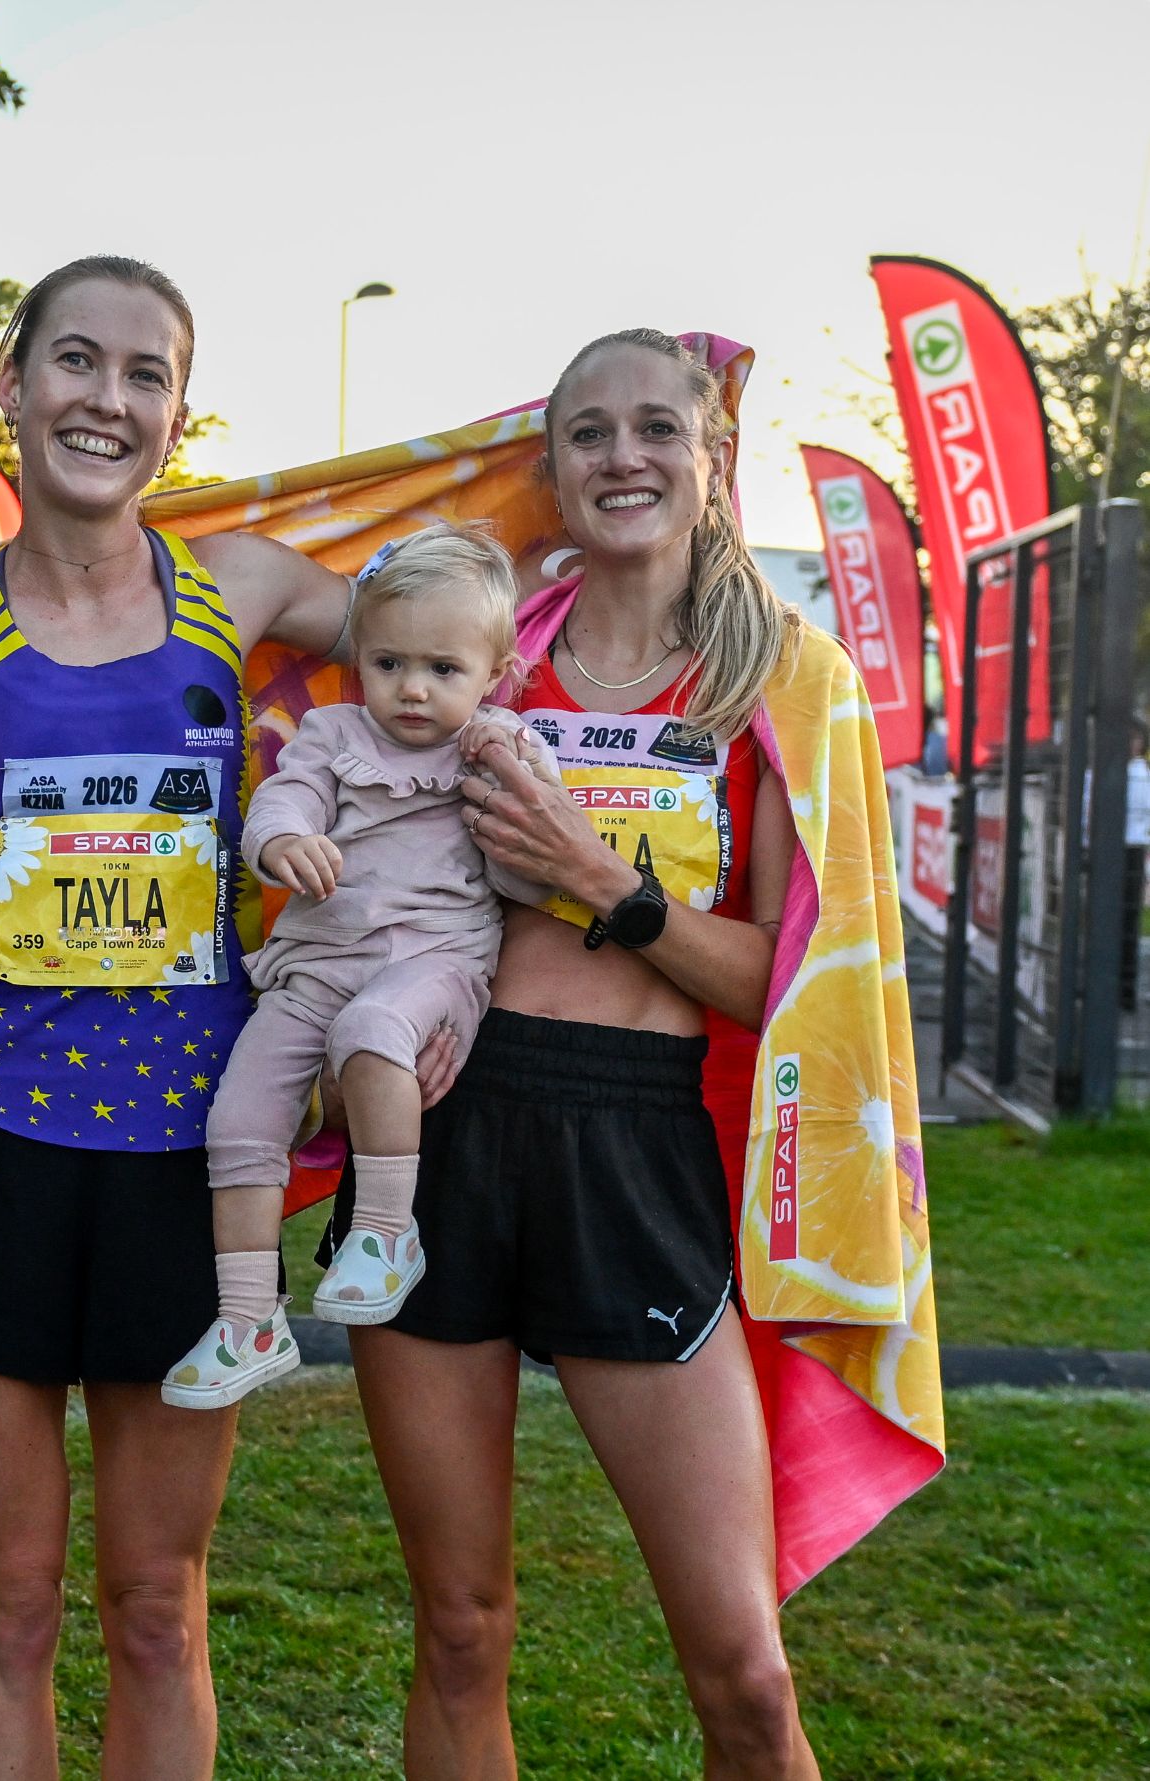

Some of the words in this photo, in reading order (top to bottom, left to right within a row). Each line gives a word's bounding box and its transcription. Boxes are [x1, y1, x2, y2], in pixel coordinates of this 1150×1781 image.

[185, 727, 234, 740] HOLLYWOOD
[531, 718, 558, 727] ASA
[579, 726, 638, 750] 2026
[583, 758, 603, 766] logos
[29, 775, 57, 787] ASA
[82, 775, 138, 806] 2026
[160, 773, 206, 795] ASA
[59, 786, 67, 794] by
[20, 793, 65, 810] KZNA
[572, 790, 648, 806] SPAR
[598, 817, 627, 826] 10KM
[719, 808, 728, 827] 353
[73, 836, 149, 851] SPAR
[720, 833, 731, 868] DRAW
[102, 862, 130, 871] 10KM
[218, 850, 228, 870] 359
[53, 877, 168, 929] TAYLA
[217, 878, 227, 913] DRAW
[12, 934, 44, 949] 359
[215, 914, 225, 953] LUCKY
[65, 939, 98, 951] Cape
[103, 939, 134, 949] Town
[137, 939, 166, 949] 2026
[176, 956, 194, 966] ASA
[774, 1105, 794, 1224] SPAR
